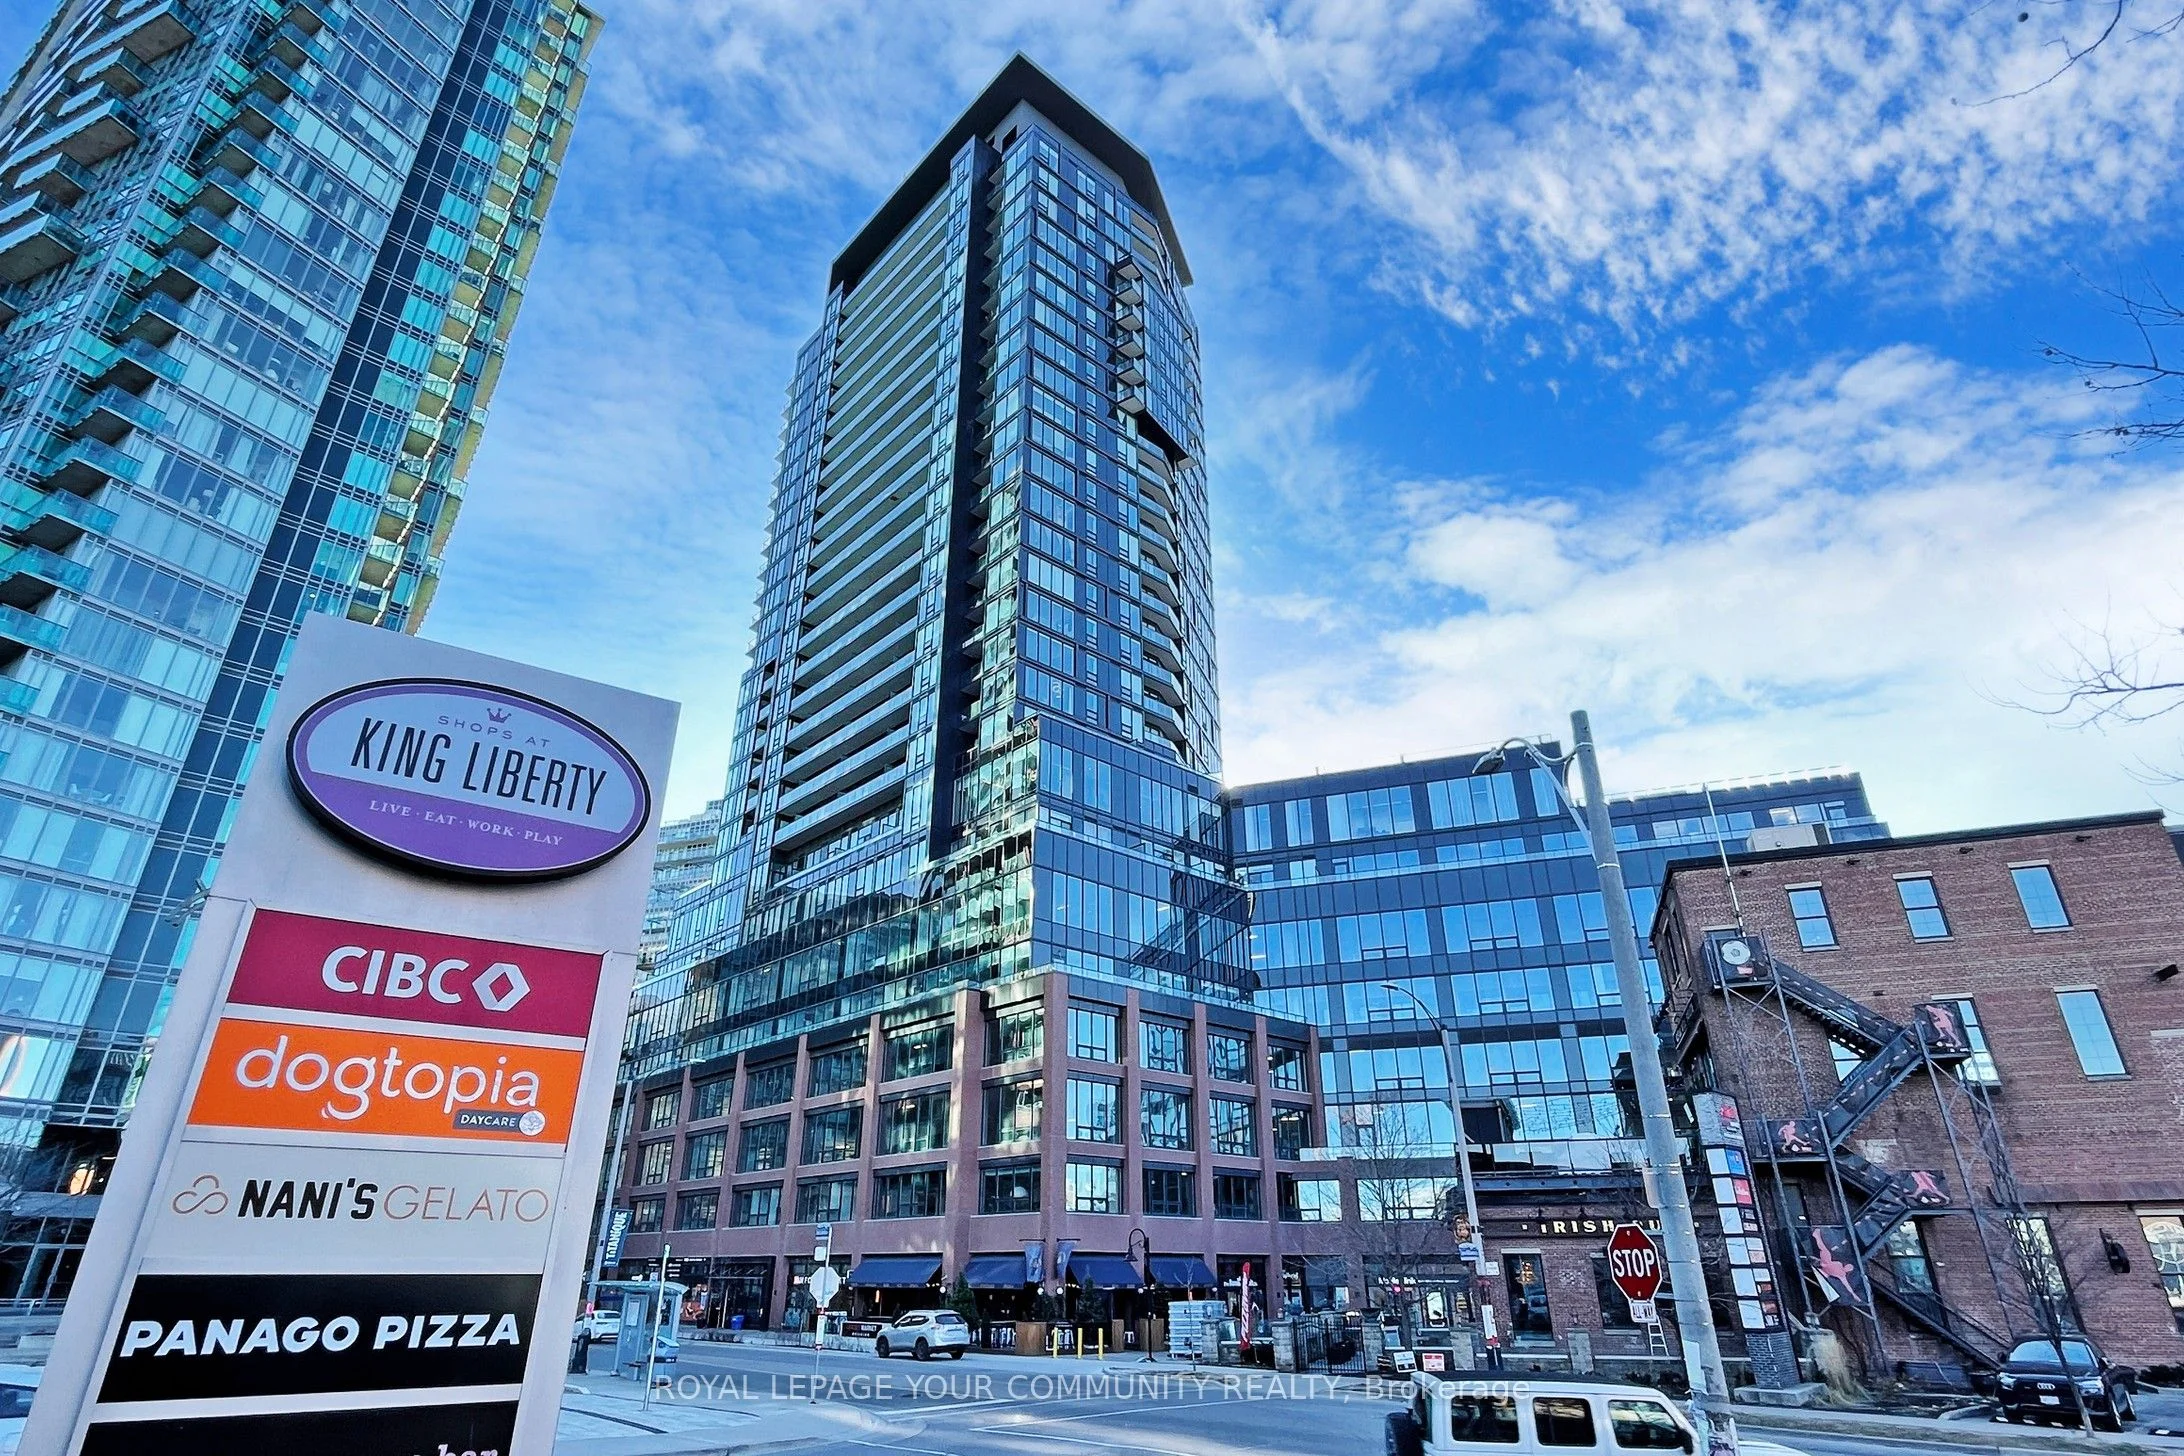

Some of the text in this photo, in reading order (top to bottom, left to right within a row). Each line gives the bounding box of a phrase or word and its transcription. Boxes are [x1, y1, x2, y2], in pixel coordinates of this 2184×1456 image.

[437, 715, 550, 748] SHOPS AT
[351, 717, 608, 815] KING LIBERTY
[368, 800, 563, 846] LIVE EAT WORK PLAY
[321, 945, 470, 1005] CIBC
[236, 1034, 541, 1121] dogtopia
[460, 1114, 517, 1128] DAYCARE
[237, 1177, 549, 1222] NANI'S GELATO
[1540, 1219, 1615, 1234] IRISH
[1612, 1248, 1655, 1278] STOP
[119, 1313, 521, 1358] PANAGO PIZZA
